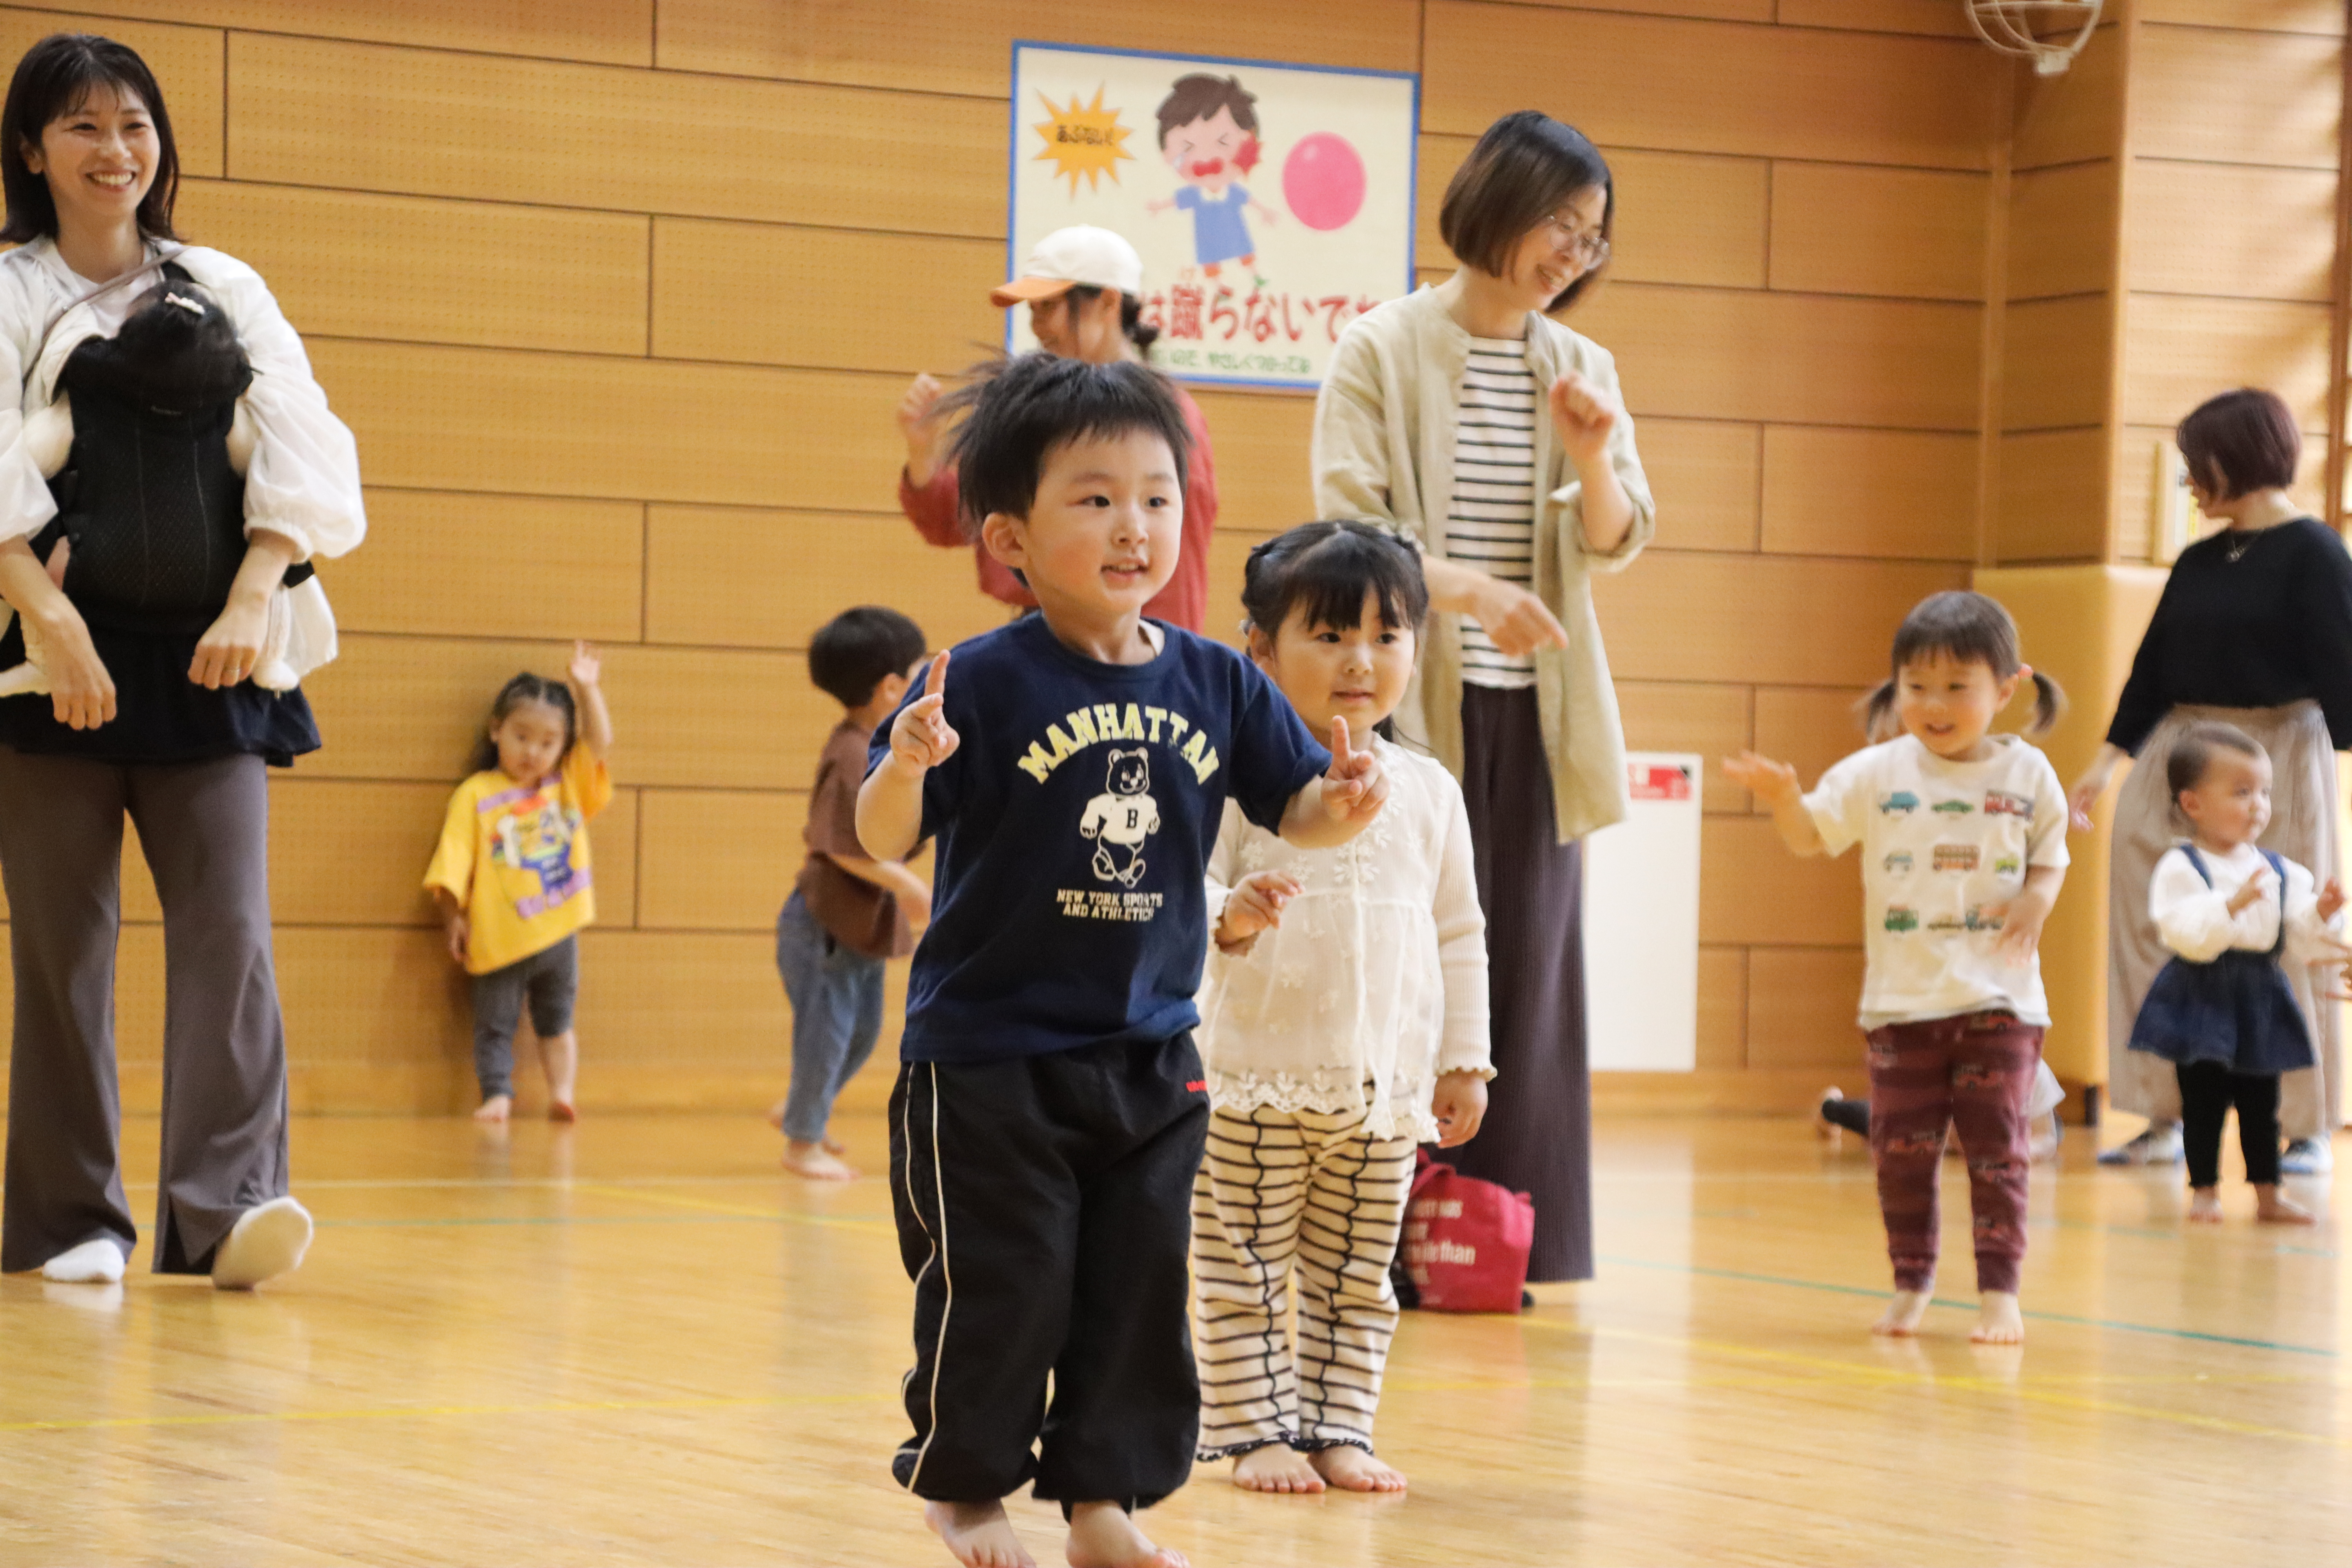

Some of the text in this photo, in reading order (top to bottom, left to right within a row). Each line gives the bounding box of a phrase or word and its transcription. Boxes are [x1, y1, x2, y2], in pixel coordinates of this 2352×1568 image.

[1018, 703, 1220, 785] MANHATTAN
[1126, 808, 1138, 829] B
[1056, 888, 1163, 908] NEW YORK SPORTS
[1063, 902, 1089, 917] AND
